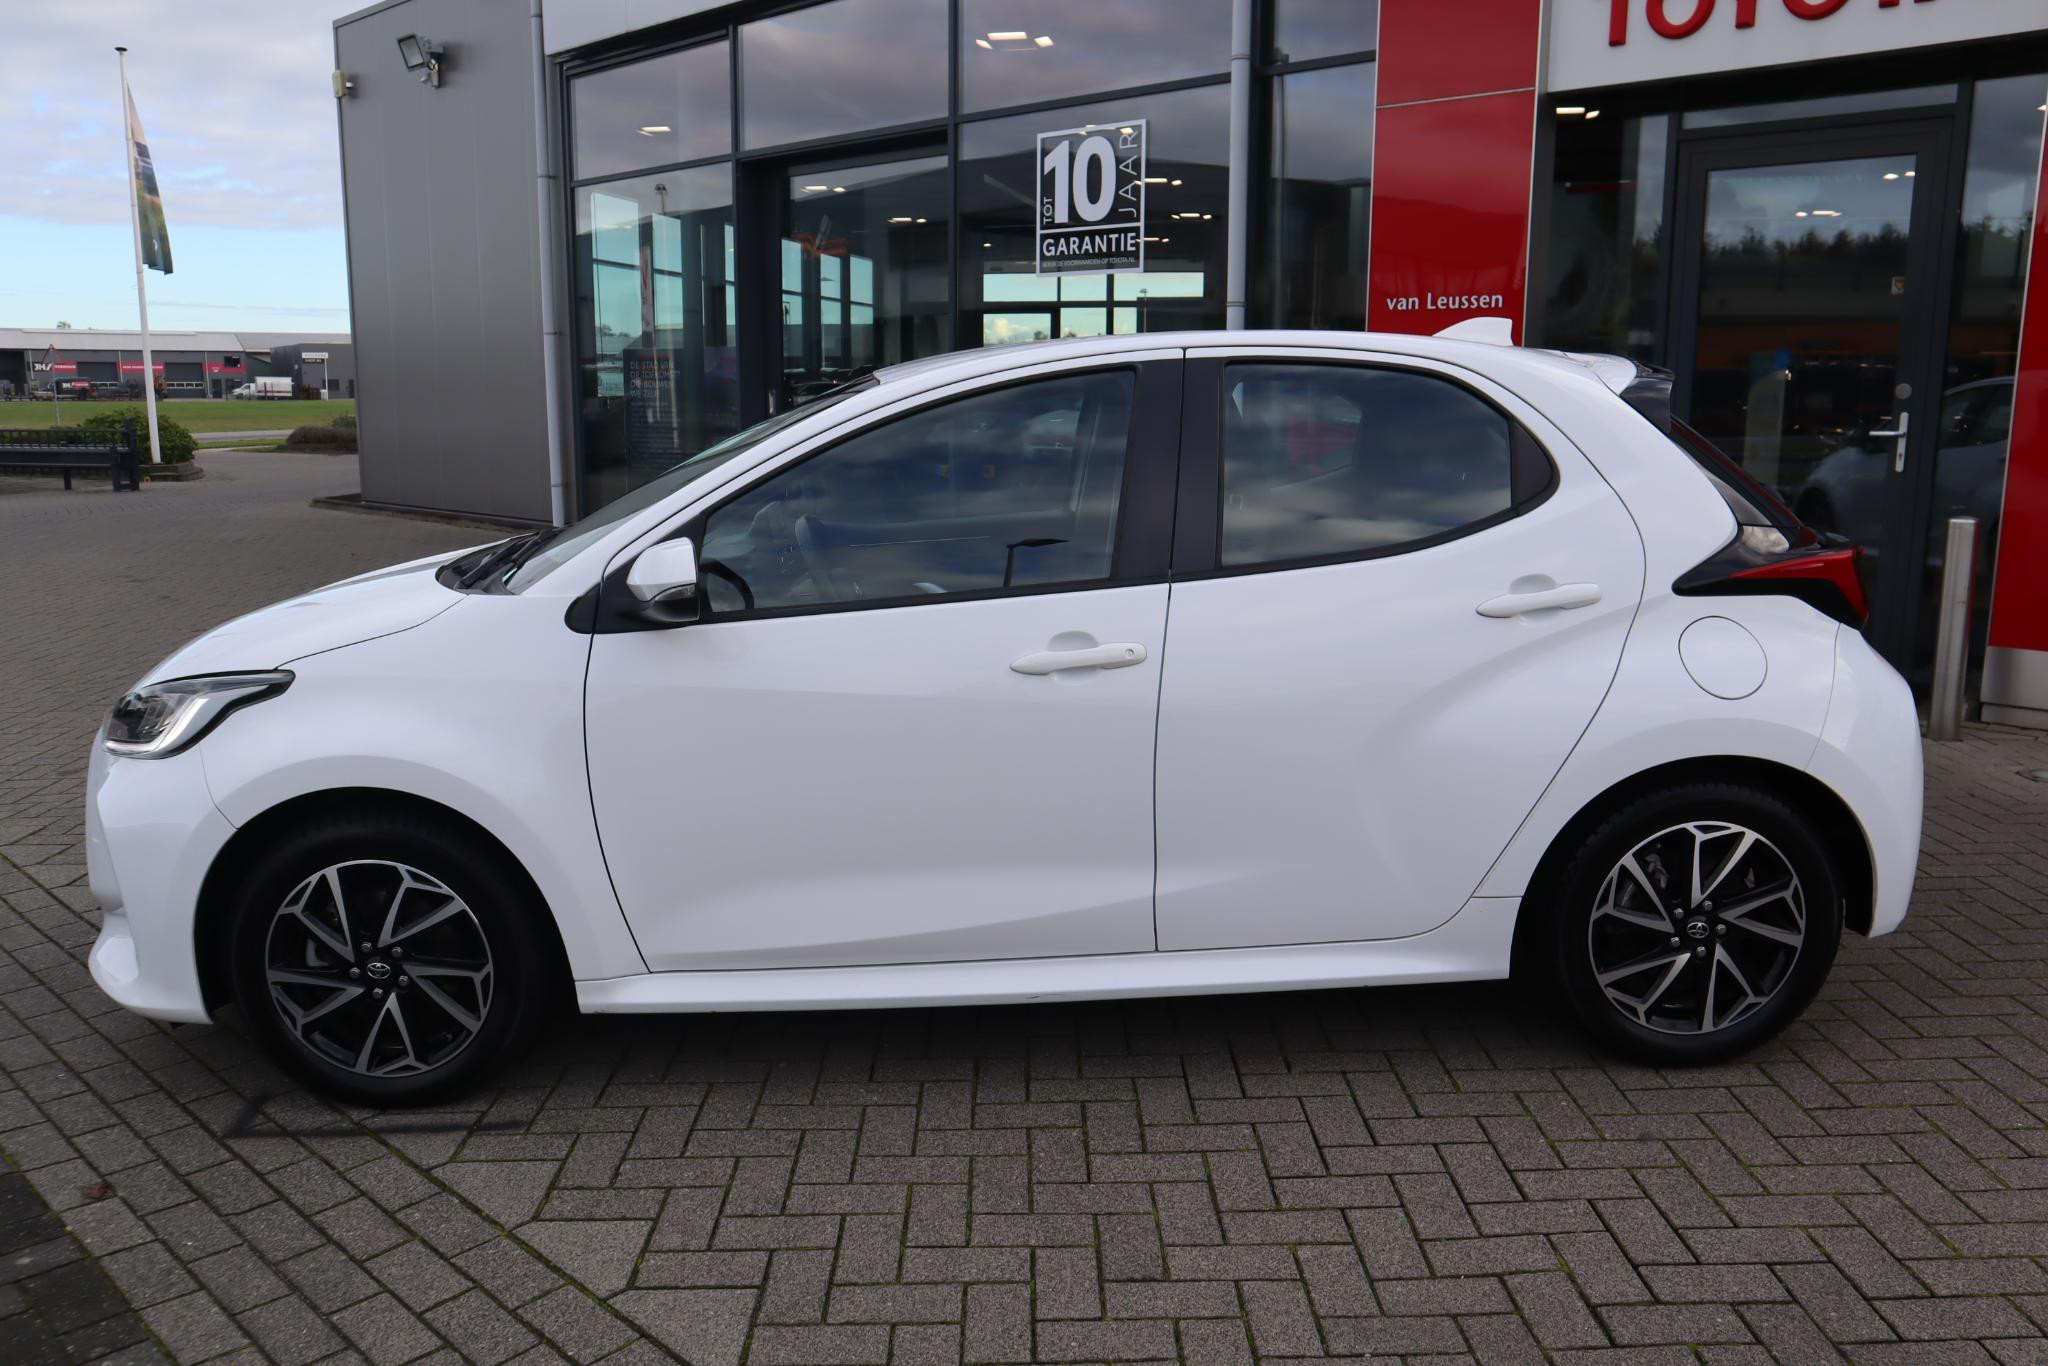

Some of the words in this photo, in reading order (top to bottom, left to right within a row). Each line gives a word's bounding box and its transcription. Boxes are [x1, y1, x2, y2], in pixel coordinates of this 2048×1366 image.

[1044, 136, 1116, 223] 10
[1118, 131, 1138, 217] JAAR
[1044, 197, 1052, 224] TOT
[1043, 233, 1136, 256] GARANTIE
[1387, 297, 1419, 310] van
[1427, 292, 1503, 309] Leussen
